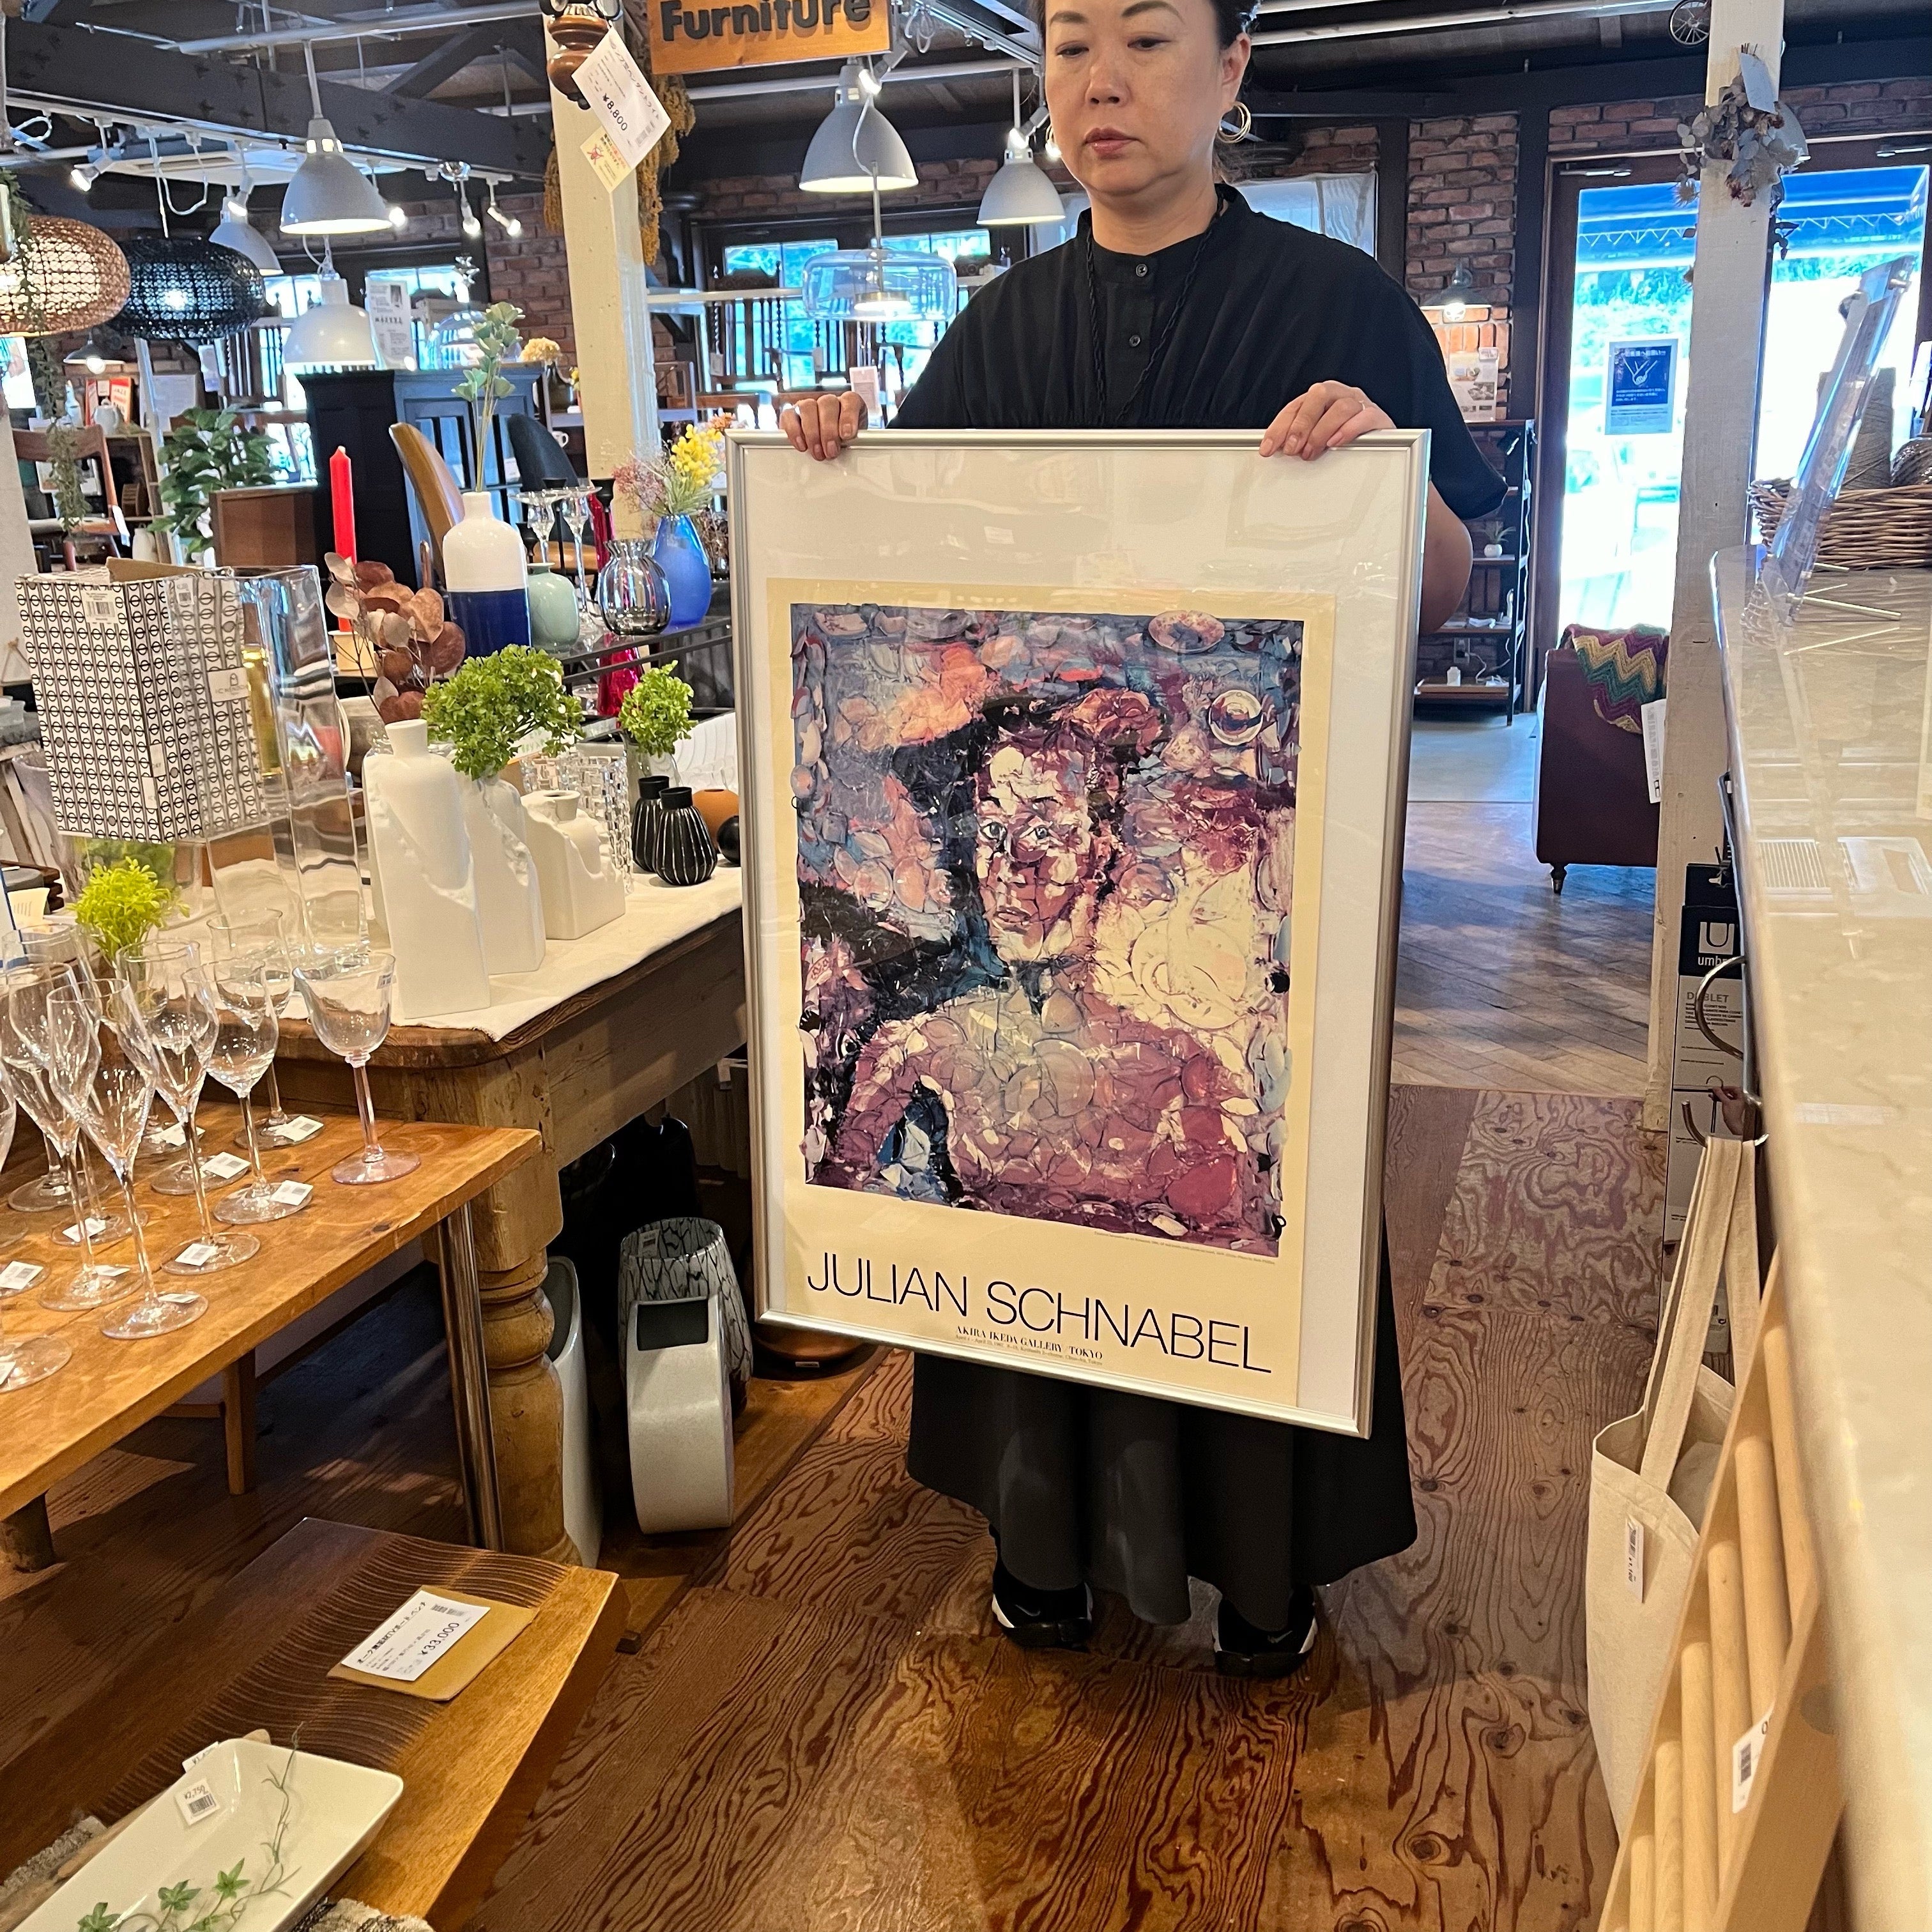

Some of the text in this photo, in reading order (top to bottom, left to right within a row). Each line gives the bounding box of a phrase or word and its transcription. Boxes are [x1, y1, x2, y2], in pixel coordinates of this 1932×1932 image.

[661, 0, 870, 42] Furniture
[1698, 955, 1728, 967] umb
[1687, 992, 1729, 1002] DBLET
[808, 1252, 1271, 1373] JULIAN SCHNABEL
[957, 1326, 1103, 1360] AKIRA IKEDA GALLERY TOKYO
[417, 1622, 460, 1656] ¥33,000
